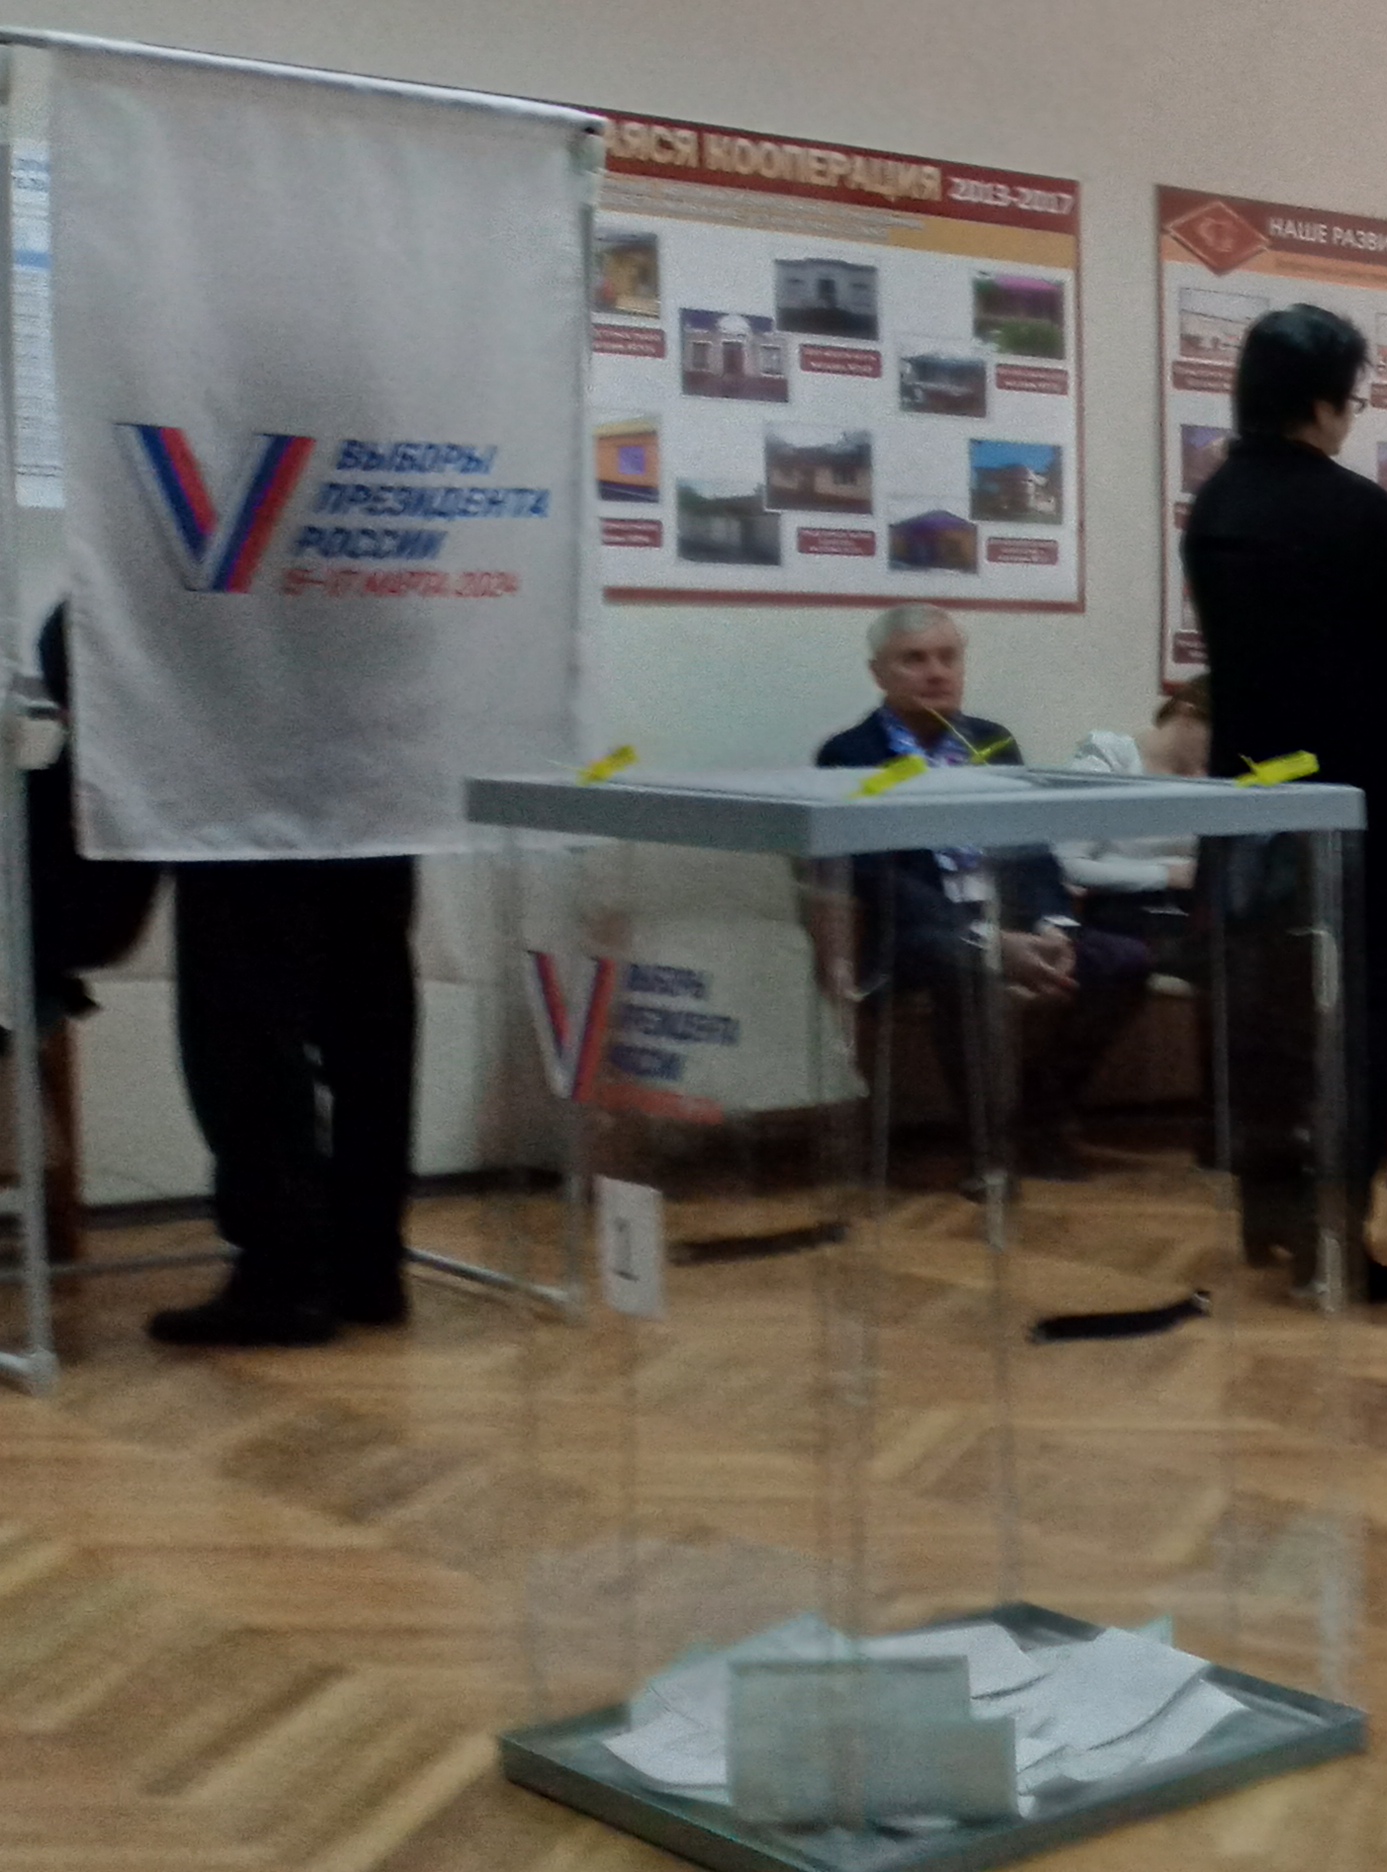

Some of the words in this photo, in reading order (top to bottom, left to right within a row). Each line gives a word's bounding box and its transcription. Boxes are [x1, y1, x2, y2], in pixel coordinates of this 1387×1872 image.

[702, 131, 942, 203] КООПЕРАЦИЯ
[1269, 216, 1328, 245] НАШЕ
[335, 438, 498, 476] ВЫБОРЫ
[312, 482, 551, 520] ПРЕЗИДЕНТА
[288, 524, 448, 561] РОССИИ
